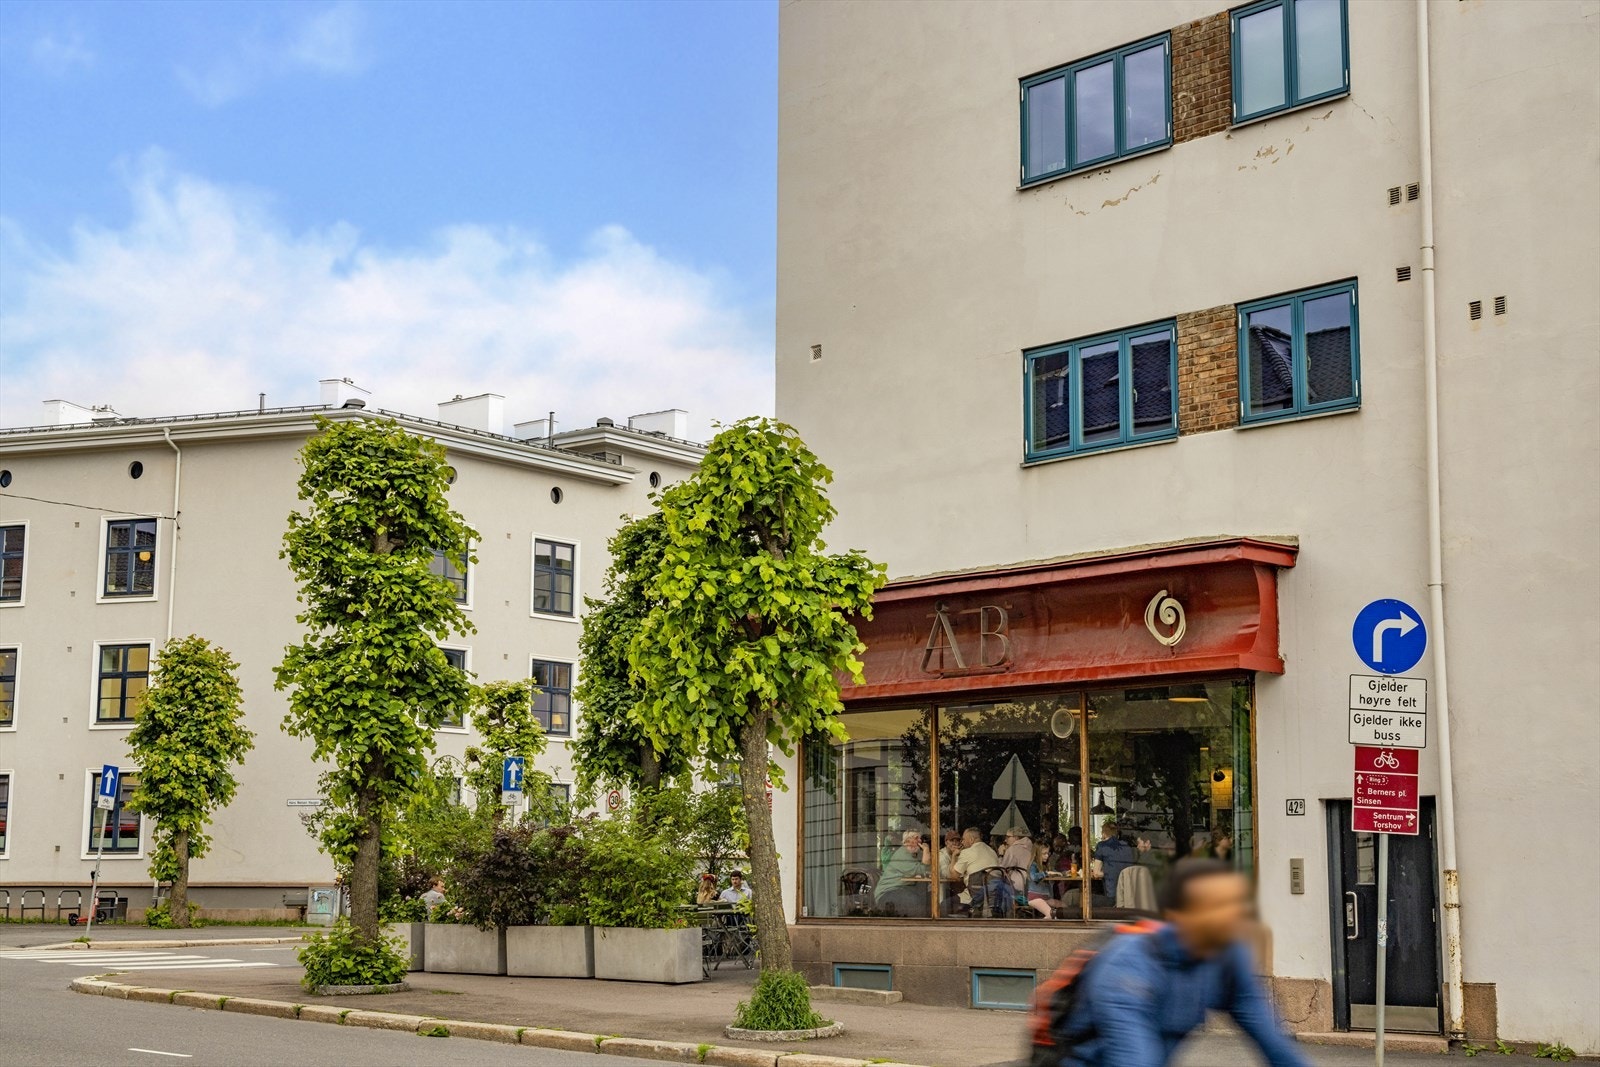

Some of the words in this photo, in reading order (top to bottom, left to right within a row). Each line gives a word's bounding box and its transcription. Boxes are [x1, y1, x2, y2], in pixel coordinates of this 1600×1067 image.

[1368, 680, 1408, 693] Gjelder
[1359, 694, 1391, 707] høyre
[1398, 696, 1417, 707] felt
[1353, 713, 1393, 727] Gjelder
[1399, 717, 1422, 727] ikke
[1374, 729, 1401, 741] buss
[1356, 787, 1364, 795] C.
[1367, 788, 1396, 796] Berners
[610, 795, 619, 805] 30
[1356, 797, 1382, 805] Sinsen
[1373, 812, 1404, 821] Sentrum
[1373, 821, 1402, 829] Torshov
